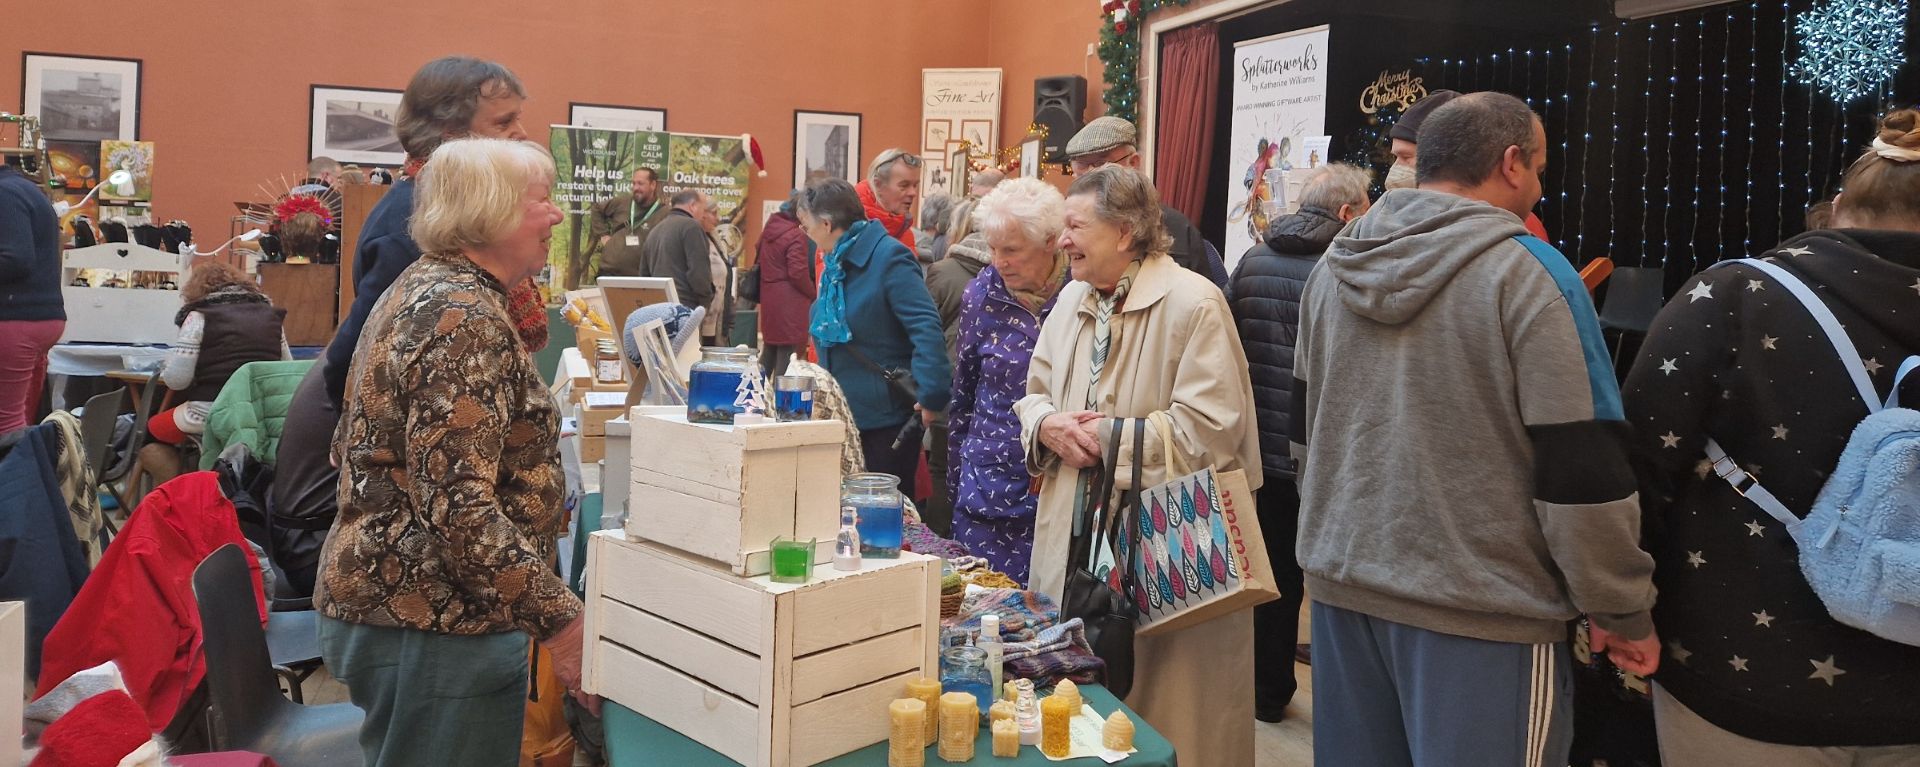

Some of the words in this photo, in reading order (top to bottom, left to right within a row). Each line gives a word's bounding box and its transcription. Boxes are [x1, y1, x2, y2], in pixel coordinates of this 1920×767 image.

[1241, 43, 1318, 83] Splatterworks
[1377, 69, 1411, 92] Merry
[1251, 82, 1258, 93] by
[926, 88, 967, 107] Fine
[968, 90, 995, 103] Art
[1360, 77, 1427, 114] Christmas
[641, 151, 663, 159] CALM
[641, 162, 661, 170] STOP
[574, 165, 605, 182] Help
[607, 170, 624, 180] us
[674, 171, 699, 184] Oak
[702, 174, 736, 186] trees
[557, 181, 595, 191] restore
[597, 182, 613, 192] the
[663, 185, 681, 193] can
[722, 188, 742, 196] over
[555, 192, 594, 203] natural
